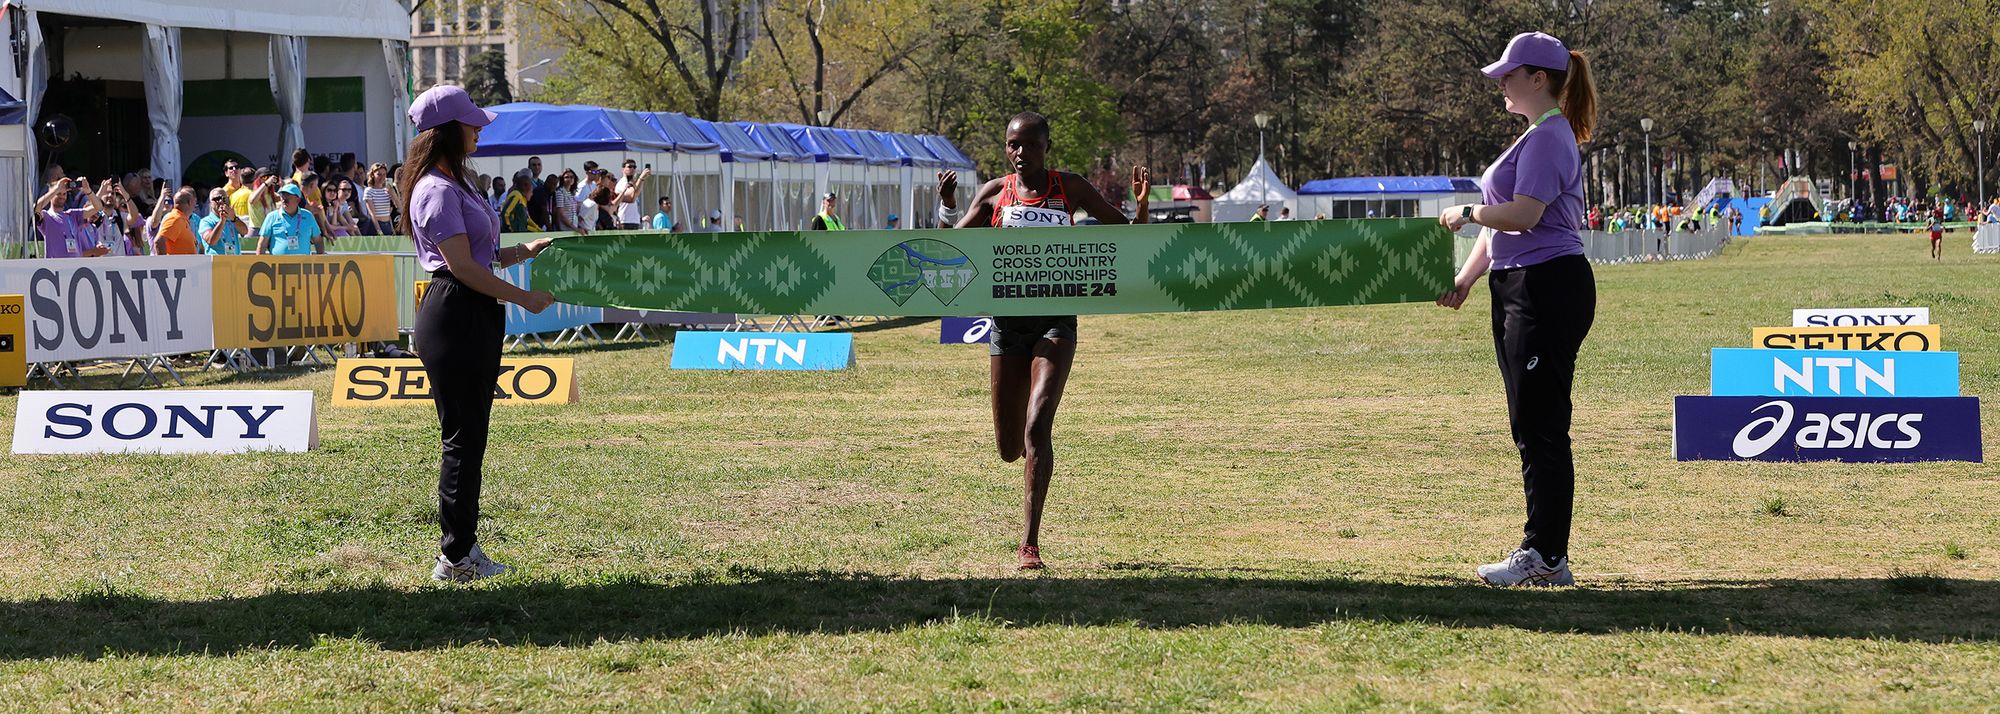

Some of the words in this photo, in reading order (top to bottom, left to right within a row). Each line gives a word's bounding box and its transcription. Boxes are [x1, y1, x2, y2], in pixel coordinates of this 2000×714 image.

[1010, 210, 1067, 225] SONY
[992, 244, 1041, 256] WORLD
[1044, 242, 1117, 255] ATHLETICS
[992, 257, 1042, 269] CROSS
[1045, 255, 1116, 268] COUNTRY
[992, 268, 1118, 283] CHAMPIONSHIPS
[992, 283, 1088, 299] BELGRADE
[1090, 282, 1117, 297] 24
[29, 267, 186, 351] SONY
[246, 259, 366, 342] SEIKO
[1806, 314, 1916, 327] SONY
[1762, 331, 1930, 351] SEIKO
[716, 337, 807, 366] NTN
[1773, 356, 1895, 396] NTN
[44, 402, 284, 440] SONY
